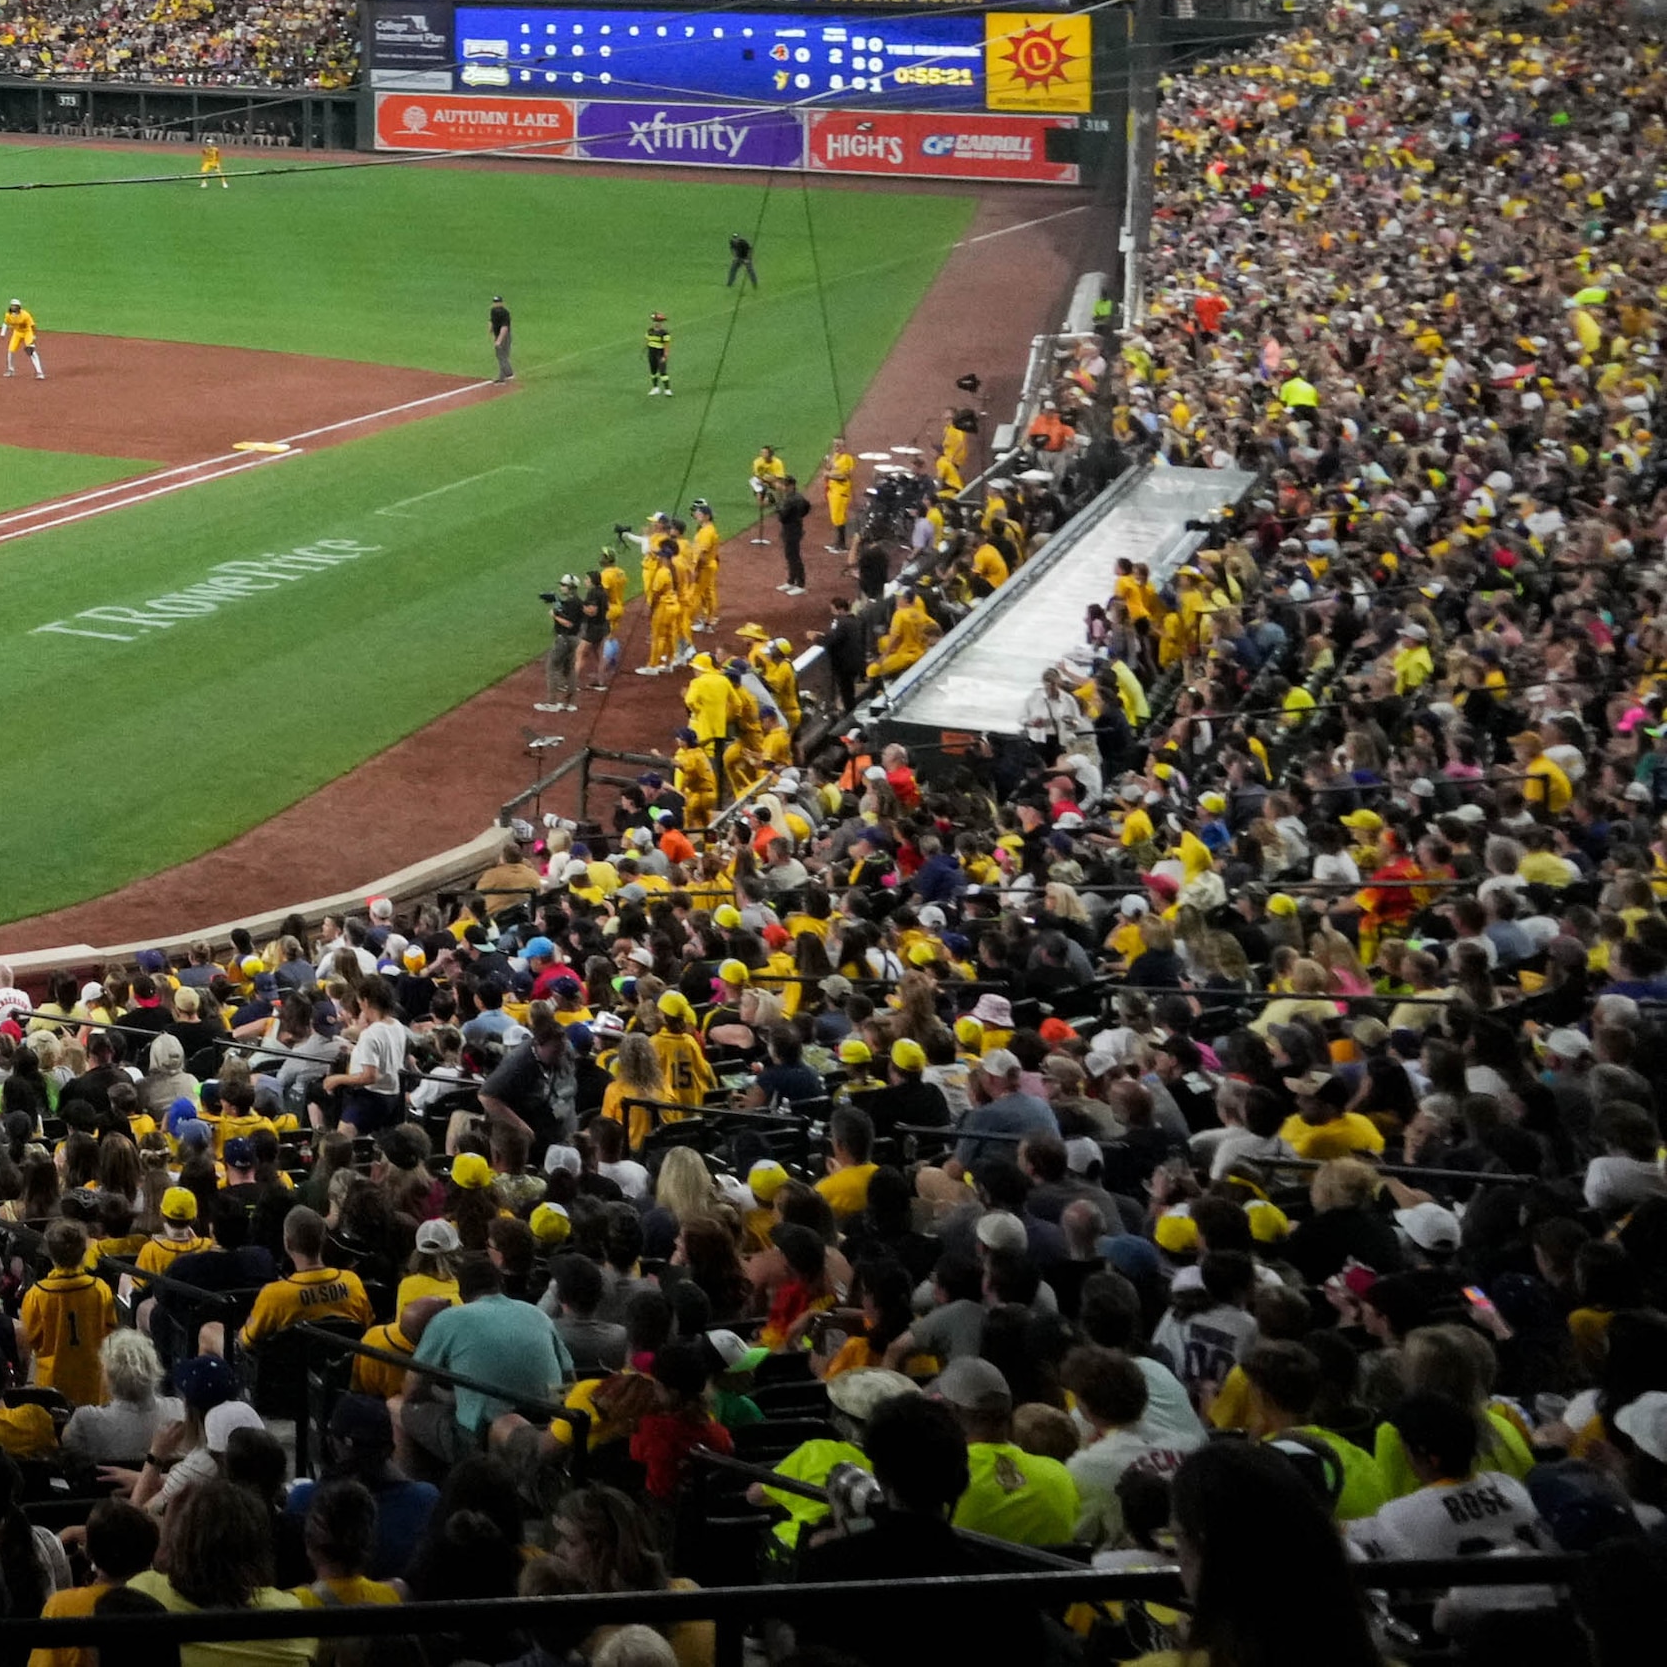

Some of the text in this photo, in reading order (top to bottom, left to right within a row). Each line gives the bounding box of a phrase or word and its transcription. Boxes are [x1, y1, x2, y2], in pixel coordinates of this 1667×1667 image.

[893, 66, 975, 86] 0:55:21
[433, 109, 560, 128] AUTUMN LAKE
[1084, 120, 1109, 132] 318
[628, 111, 750, 158] xfinity
[955, 135, 1033, 153] CARROLL
[826, 133, 904, 165] HIGH'S
[671, 1061, 693, 1089] 15
[298, 1282, 348, 1308] OLSON
[66, 1311, 80, 1347] 1
